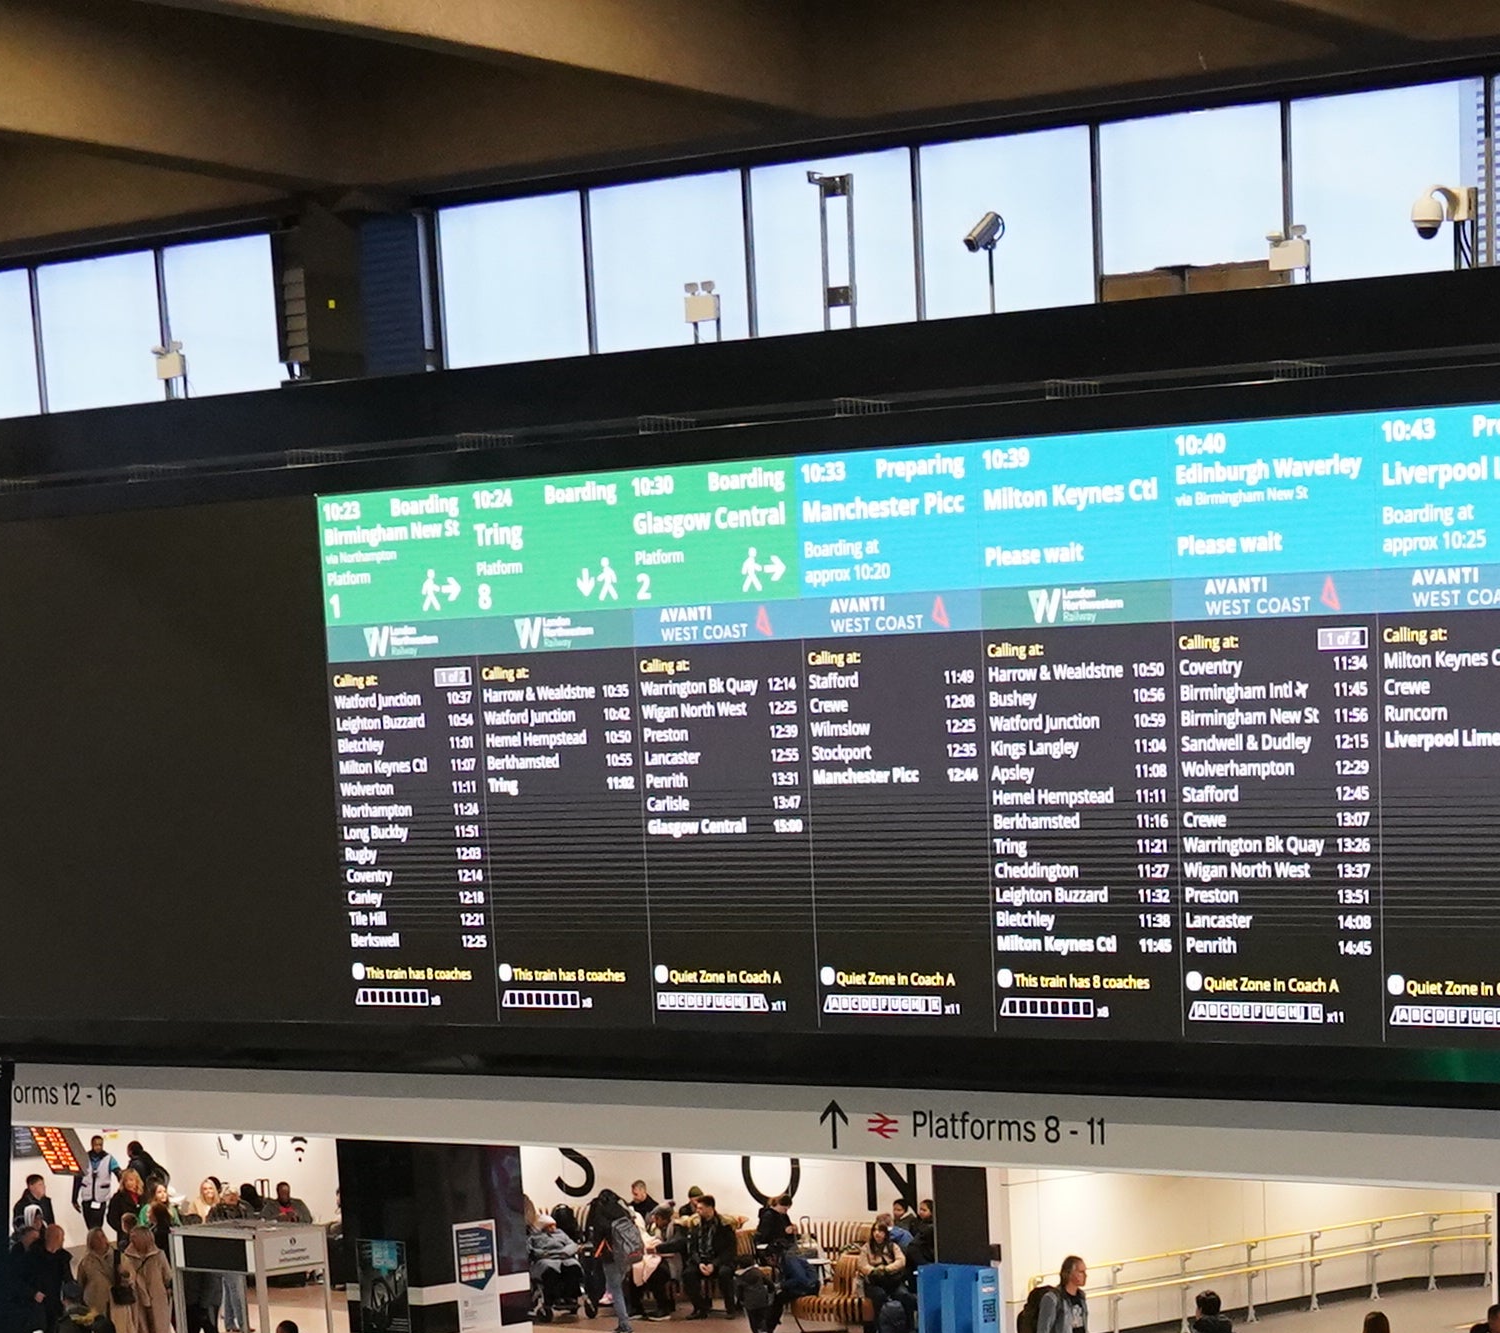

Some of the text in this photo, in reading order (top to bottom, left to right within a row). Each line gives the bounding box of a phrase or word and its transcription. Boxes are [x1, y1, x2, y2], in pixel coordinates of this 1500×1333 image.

[632, 470, 785, 497] 10:30 Boarding
[633, 503, 785, 537] Glasgow Central
[474, 524, 523, 550] Tring
[635, 550, 684, 566] Platform
[636, 575, 651, 600] 2
[1412, 567, 1479, 586] AVANTI
[1413, 590, 1460, 608] WEST
[1179, 658, 1242, 678] Coventry
[1182, 759, 1295, 780] Wolverhampton
[63, 1083, 80, 1105] 12
[97, 1084, 116, 1107] 16
[912, 1110, 1036, 1143] Platforms
[1044, 1116, 1060, 1143] 8
[1087, 1117, 1105, 1145] 11
